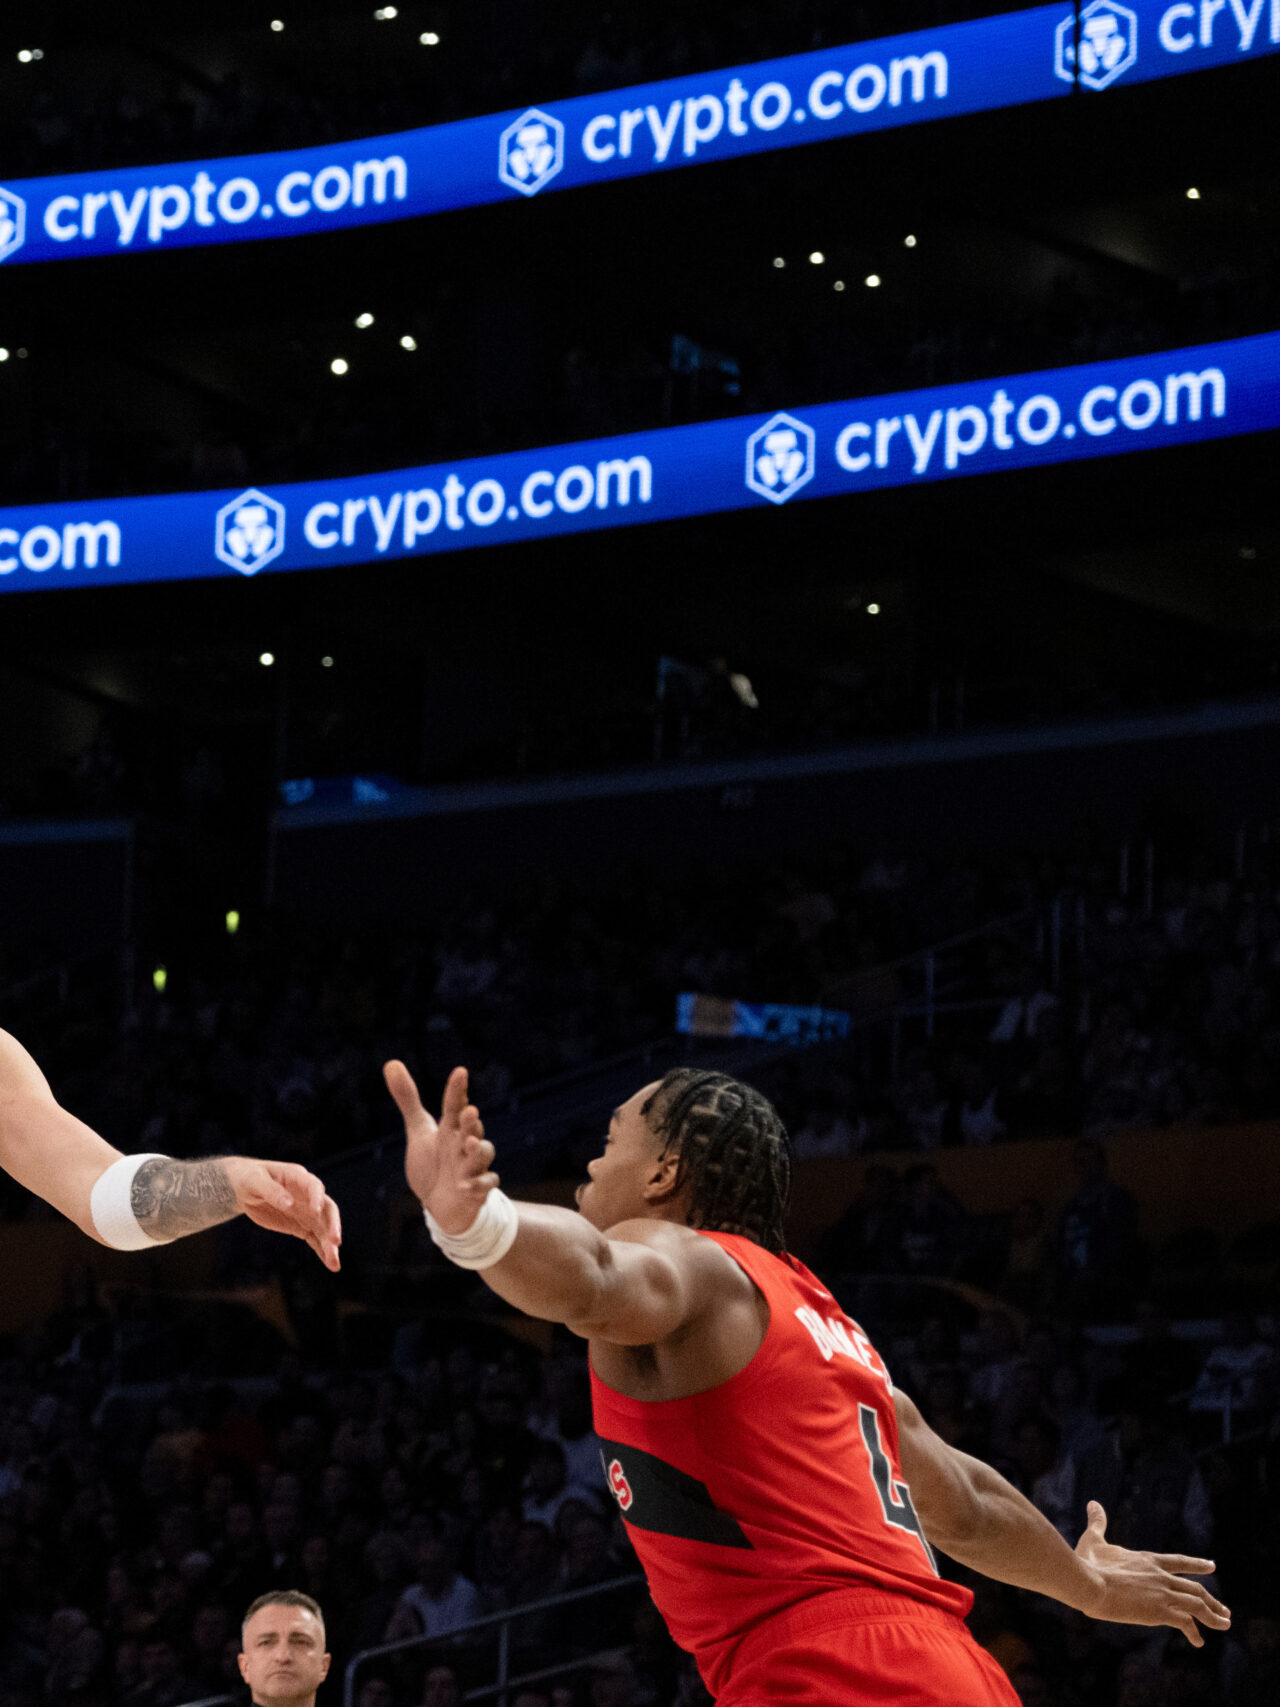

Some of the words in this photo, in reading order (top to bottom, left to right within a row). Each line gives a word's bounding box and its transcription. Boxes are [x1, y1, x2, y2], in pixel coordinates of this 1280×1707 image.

[1159, 0, 1280, 52] cry
[582, 51, 949, 162] crypto.com
[44, 156, 408, 245] crypto.com
[835, 368, 1227, 474] crypto.com
[304, 455, 653, 552] crypto.com
